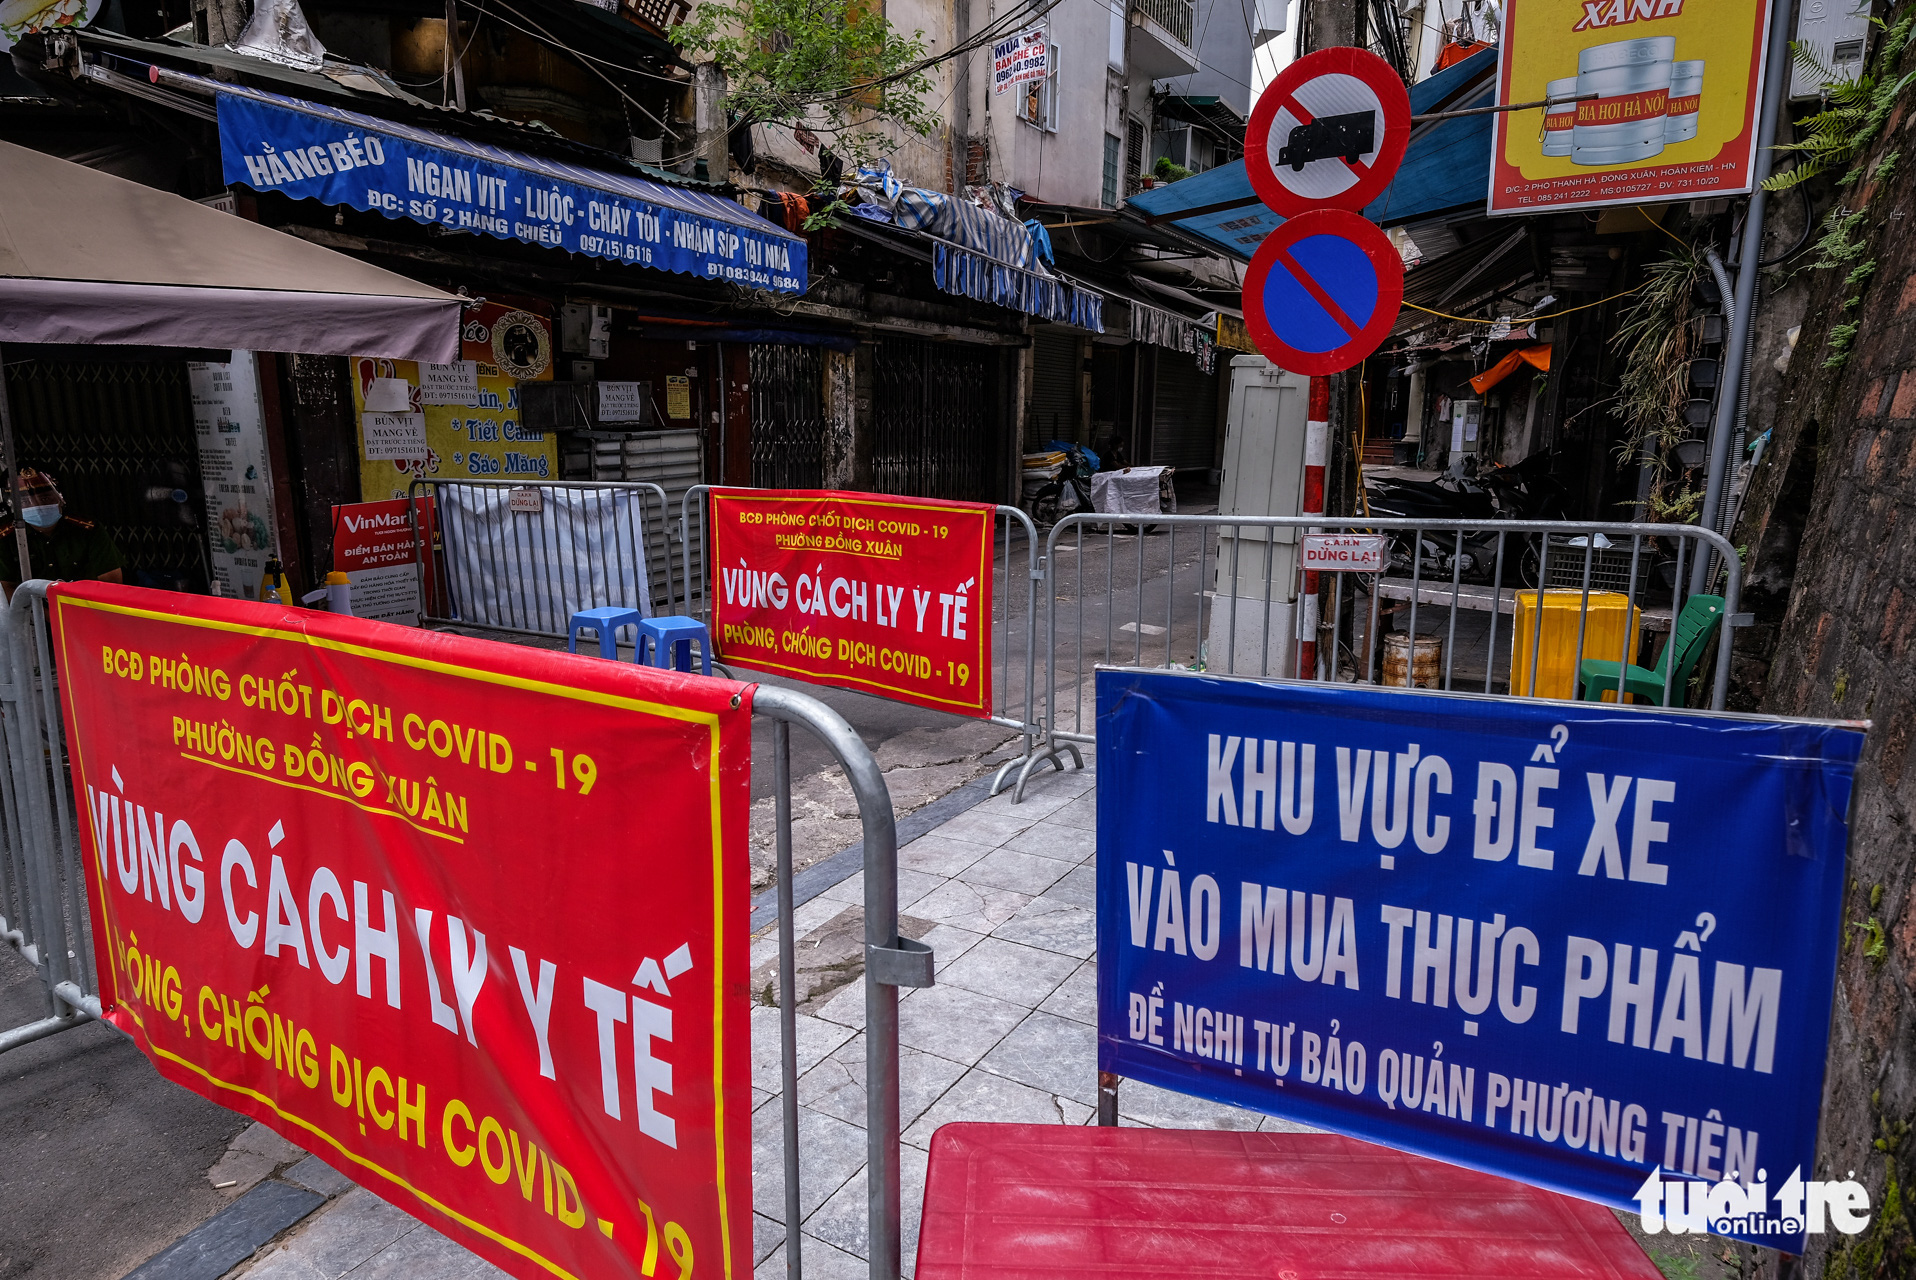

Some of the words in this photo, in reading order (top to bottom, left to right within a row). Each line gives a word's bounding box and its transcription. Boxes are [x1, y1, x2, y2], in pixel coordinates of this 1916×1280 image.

[1573, 0, 1683, 31] XANH
[995, 38, 1020, 59] MUA
[995, 56, 1012, 71] BÀN
[1013, 46, 1029, 62] GHẾ
[1033, 42, 1045, 56] CŨ
[1578, 105, 1596, 121] BIA
[1598, 102, 1621, 120] HƠI
[1624, 96, 1641, 117] HÀ
[1645, 92, 1666, 116] NỘI
[1670, 99, 1682, 114] HÀ
[1683, 96, 1698, 112] NỘI
[1545, 117, 1558, 128] BIA
[1559, 115, 1573, 127] HƠI
[244, 141, 335, 186] HẰNG
[327, 132, 386, 172] BÉO
[1505, 186, 1523, 194] Đ/C:
[1552, 178, 1582, 188] THANH
[1584, 175, 1597, 185] HÀ
[1630, 169, 1658, 180] XUÂN,
[1660, 166, 1688, 177] HOÀN
[1689, 163, 1713, 173] KIẾM
[1721, 162, 1736, 171] HN
[1518, 196, 1536, 204] TEL:
[1537, 194, 1552, 202] 085
[1553, 192, 1568, 200] 241
[1570, 190, 1591, 198] 2222
[1659, 181, 1675, 189] ĐV:
[368, 189, 403, 212] ĐC:
[409, 198, 437, 220] SỐ
[442, 207, 454, 224] 2
[458, 210, 508, 233] HÀNG
[514, 221, 562, 245] CHIẾU
[580, 233, 652, 263] 097.151.6116
[407, 157, 474, 204] NGAN
[476, 172, 507, 215] VỊT
[525, 186, 575, 230] LUỘC
[588, 201, 630, 237] CHÁY
[636, 206, 661, 244] TỎI
[673, 219, 715, 258] NHẬN
[717, 228, 740, 259] SÍP
[743, 236, 762, 268] TẠI
[765, 242, 791, 272] NHÀ
[428, 374, 456, 383] MANG
[373, 429, 403, 438] MANG
[375, 414, 395, 425] BÚN
[397, 417, 414, 427] VỊT
[465, 419, 498, 441] Tiết
[369, 447, 383, 455] ĐT:
[385, 446, 425, 454] 0971516116
[468, 452, 500, 474] Sáo
[504, 452, 549, 478] Măng
[739, 511, 763, 525] BCĐ
[765, 511, 805, 526] PHÒNG
[808, 510, 841, 528] CHỐT
[843, 517, 875, 533] DỊCH
[879, 519, 920, 536] COVID
[933, 525, 949, 539] 19
[344, 544, 370, 557] ĐIỂM
[373, 543, 394, 553] BÁN
[362, 555, 378, 564] AN
[380, 551, 409, 562] TOÀN
[775, 532, 822, 548] PHƯỜNG
[824, 531, 863, 552] ĐỒNG
[865, 540, 903, 557] XUÂN
[1307, 546, 1348, 561] DỪNG
[722, 556, 789, 611] VÙNG
[795, 562, 867, 623] CÁCH
[876, 583, 904, 629] LY
[912, 587, 931, 633] Y
[939, 575, 975, 641] TẾ
[724, 620, 778, 653] PHÒNG,
[782, 625, 832, 660] CHỐNG
[838, 638, 876, 668] DỊCH
[880, 647, 931, 680] COVID
[947, 661, 970, 687] 19
[102, 645, 144, 681] BCĐ
[150, 652, 231, 701] PHÒNG
[239, 668, 312, 719] CHỐT
[321, 689, 394, 743] DỊCH
[402, 713, 513, 774] COVID
[550, 747, 597, 796] 19
[173, 716, 275, 770] PHƯỜNG
[284, 731, 374, 797] ĐỒNG
[378, 776, 469, 834] XUÂN
[1207, 733, 1316, 836] KHU
[1336, 743, 1453, 870] VỰC
[1473, 723, 1569, 871] ĐỂ
[1577, 772, 1676, 886] XE
[87, 764, 205, 924] VÙNG
[220, 818, 401, 1010] CÁCH
[415, 907, 488, 1049] LY
[508, 945, 557, 1081] Y
[583, 942, 694, 1150] TẾ
[1126, 849, 1221, 961] VÀO
[1240, 882, 1359, 991] MUA
[1381, 904, 1540, 1036] THỰC
[1560, 911, 1783, 1074] PHẨM
[1128, 981, 1164, 1047] ĐỀ
[1173, 1001, 1244, 1077] NGHỊ
[1254, 1019, 1295, 1087] TỰ
[1301, 1019, 1367, 1096] BẢO
[1378, 1040, 1475, 1123] QUẢN
[1486, 1071, 1648, 1164] PHƯƠNG
[199, 984, 320, 1089] CHỐNG
[330, 1043, 426, 1148] DỊCH
[442, 1099, 586, 1229] COVID
[638, 1198, 694, 1280] 19
